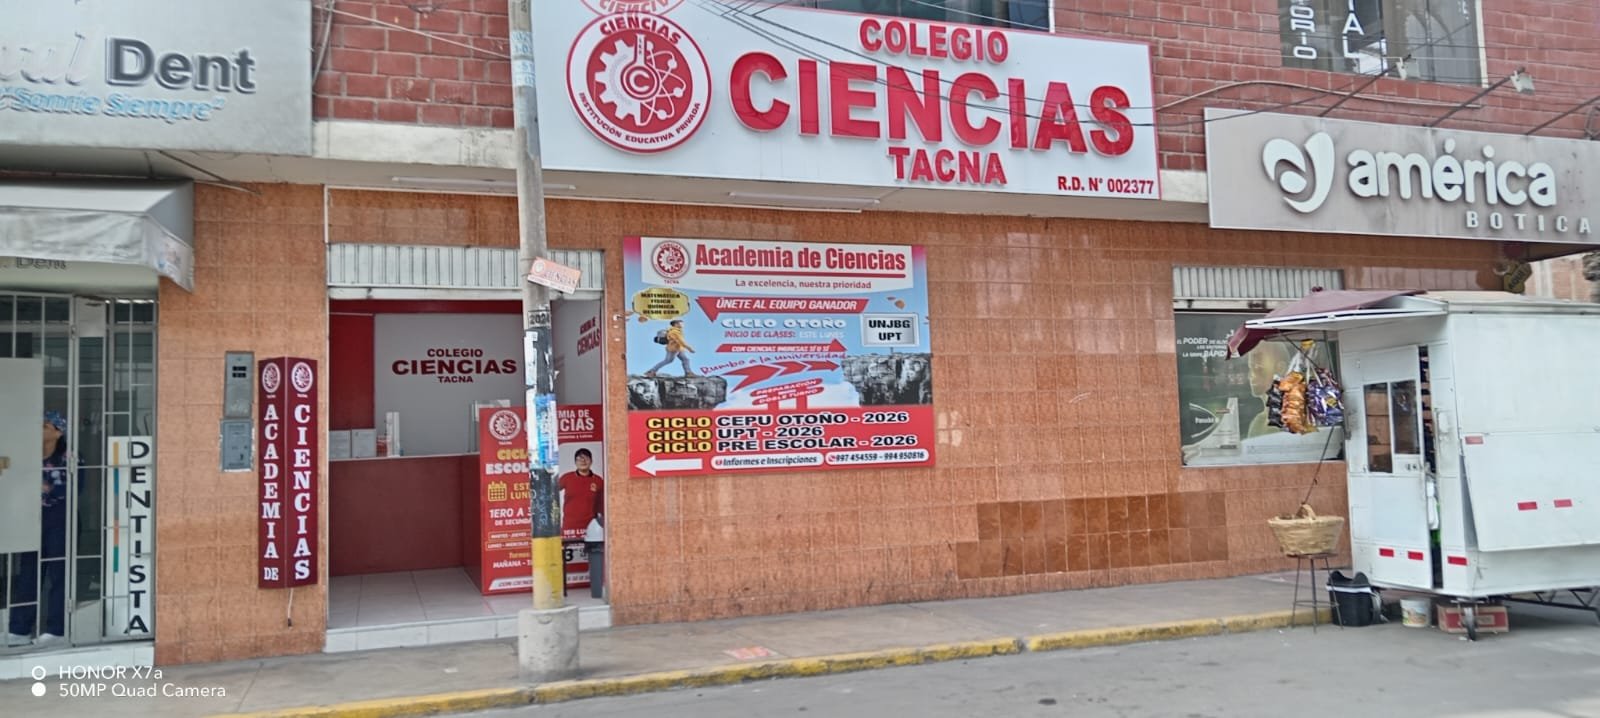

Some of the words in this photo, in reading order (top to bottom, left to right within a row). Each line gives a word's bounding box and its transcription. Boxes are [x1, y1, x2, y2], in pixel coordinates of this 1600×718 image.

[600, 16, 682, 45] CIENCIAS
[1289, 0, 1318, 60] ORIO
[859, 17, 1009, 64] COLEGIO
[105, 36, 256, 94] Dent
[729, 51, 1135, 157] CIENCIAS
[579, 92, 622, 138] INSTITUCIÓN
[625, 132, 675, 144] EDUCATIVA
[675, 102, 701, 134] PRIVADA
[888, 146, 1008, 186] TACNA
[1347, 138, 1557, 207] américa
[1057, 175, 1085, 193] R.D.
[1107, 178, 1154, 196] 002377
[1465, 209, 1593, 235] BOTICA
[695, 243, 794, 269] Academia
[799, 247, 827, 270] de
[829, 248, 906, 271] Ciencias
[735, 279, 746, 288] La
[748, 279, 798, 290] excelencia,
[799, 280, 831, 289] nuestra
[833, 280, 872, 291] prioridad
[716, 296, 751, 309] ÚNETE
[754, 300, 768, 310] AL
[770, 300, 806, 310] EQUIPO
[808, 300, 857, 312] GANADOR
[721, 318, 777, 329] CICLO
[783, 316, 847, 329] OTOÑO
[868, 318, 911, 331] UNJBG
[724, 330, 749, 338] INICIO
[750, 330, 761, 338] DE
[878, 332, 902, 343] UPT
[1183, 337, 1208, 345] PODER
[427, 349, 483, 358] COLEGIO
[392, 359, 517, 375] CIENCIAS
[700, 359, 746, 375] Rumbo
[749, 357, 758, 365] a
[761, 354, 773, 364] la
[775, 351, 848, 361] universidad
[438, 375, 474, 384] TACNA
[578, 410, 590, 418] DE
[647, 416, 711, 429] CICLO
[716, 415, 771, 427] CEPU
[777, 411, 847, 426] OTOÑO
[864, 412, 908, 423] 2026
[647, 429, 711, 441] CICLO
[717, 428, 757, 440] UPT
[777, 426, 823, 438] 2026
[647, 441, 711, 454] CICLO
[717, 438, 758, 451] PRE
[765, 437, 855, 449] ESCOLAR
[874, 435, 917, 447] 2026
[497, 449, 528, 460] CICL
[723, 458, 759, 467] Informes
[767, 456, 818, 468] Inscripciones
[486, 462, 530, 475] ESCOL
[263, 404, 280, 559] ACADEMIA
[514, 482, 530, 490] EST
[293, 404, 311, 580] CIENCIAS
[511, 491, 530, 499] LUN
[489, 508, 513, 518] 1ERO
[517, 508, 524, 516] A
[125, 441, 151, 634] DENTISTA
[264, 567, 279, 580] DE
